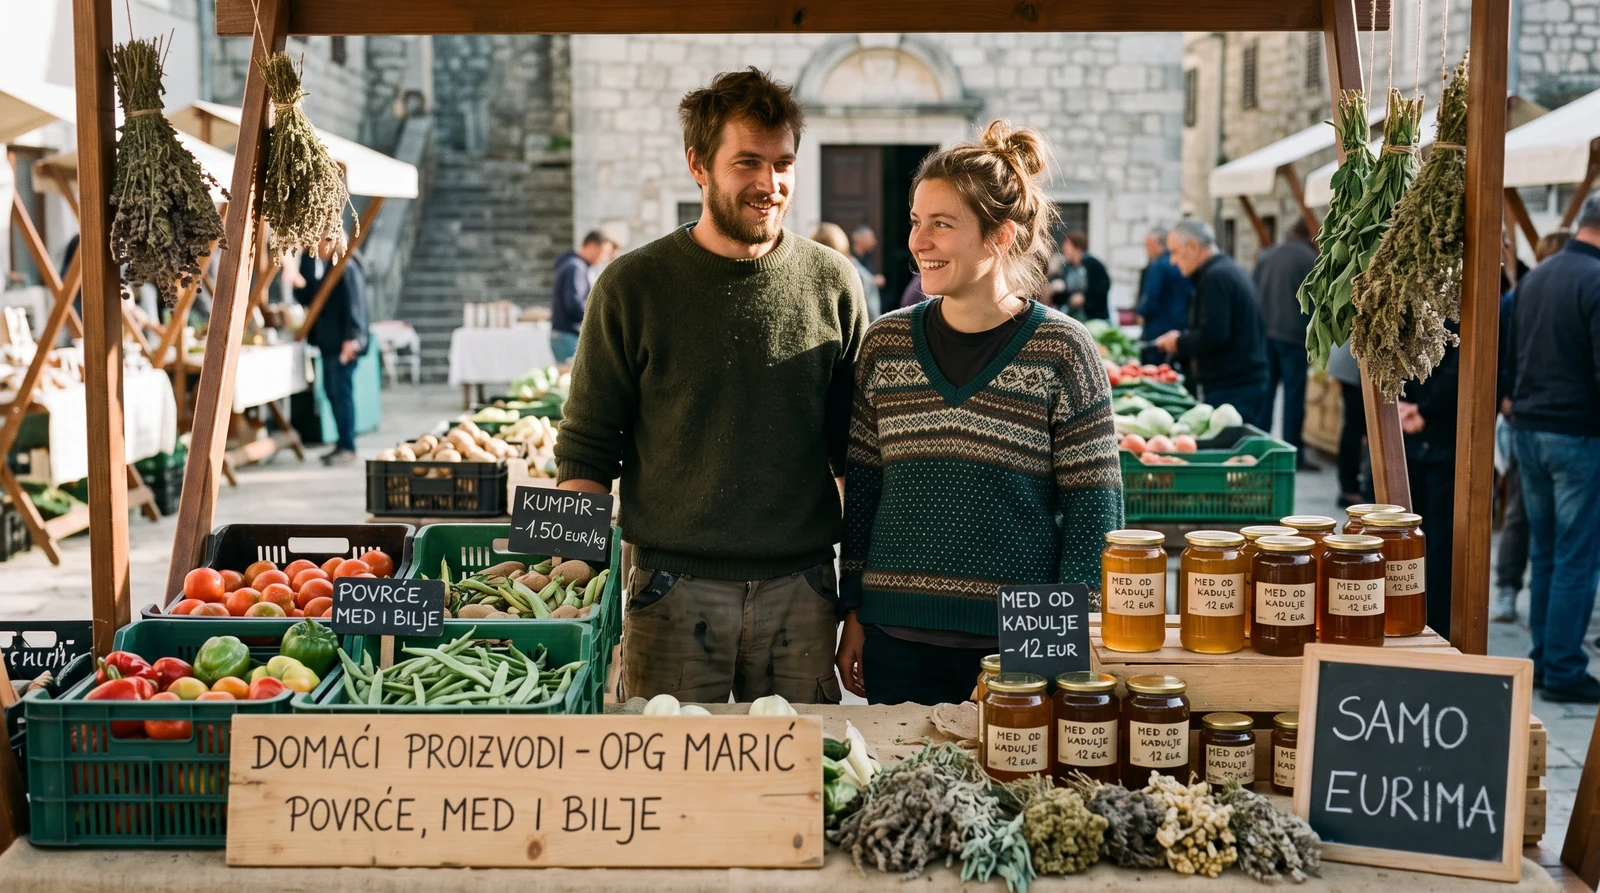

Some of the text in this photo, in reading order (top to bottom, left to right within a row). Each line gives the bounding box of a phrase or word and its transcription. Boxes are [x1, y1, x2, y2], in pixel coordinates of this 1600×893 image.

[565, 528, 606, 550] EUR/kg
[1112, 577, 1133, 585] MED
[1195, 578, 1215, 586] MED
[1336, 582, 1360, 590] MED
[339, 580, 428, 607] POVRĆE,
[1115, 588, 1155, 598] KADULJE
[1197, 589, 1236, 598] KADULJE
[1265, 588, 1287, 597] MED
[1338, 593, 1372, 601] KADULJE
[1001, 591, 1074, 608] MED OD
[1123, 600, 1134, 609] 12
[1205, 601, 1217, 610] 12
[1265, 600, 1305, 610] KADULJE
[1348, 603, 1359, 611] 12
[336, 608, 440, 632] MED I BILJE
[1274, 612, 1286, 621] 12
[1002, 615, 1078, 636] KADULJE
[1047, 643, 1078, 657] EUR
[1332, 696, 1468, 749] SAMO
[1064, 725, 1085, 734] MED
[1138, 727, 1178, 736] MED OD
[997, 732, 1041, 741] MED OD
[251, 723, 380, 770] DOMAĆI
[404, 733, 564, 770] PROIZVODI
[599, 731, 666, 772] OPG
[683, 721, 796, 772] MARIĆ
[1067, 737, 1108, 748] KADULJE
[1141, 739, 1181, 749] KADULJE
[995, 743, 1038, 754] KADULJE
[1209, 747, 1230, 757] MED
[1075, 750, 1088, 760] 12
[1149, 751, 1161, 761] 12
[1281, 750, 1296, 759] ME
[1005, 757, 1017, 766] 12
[1020, 758, 1037, 766] EUR
[1209, 760, 1247, 770] KADULJE
[1278, 761, 1295, 770] KAD
[1325, 770, 1496, 834] EURIMA
[284, 785, 662, 845] POVRĆE, MED I BILJE
